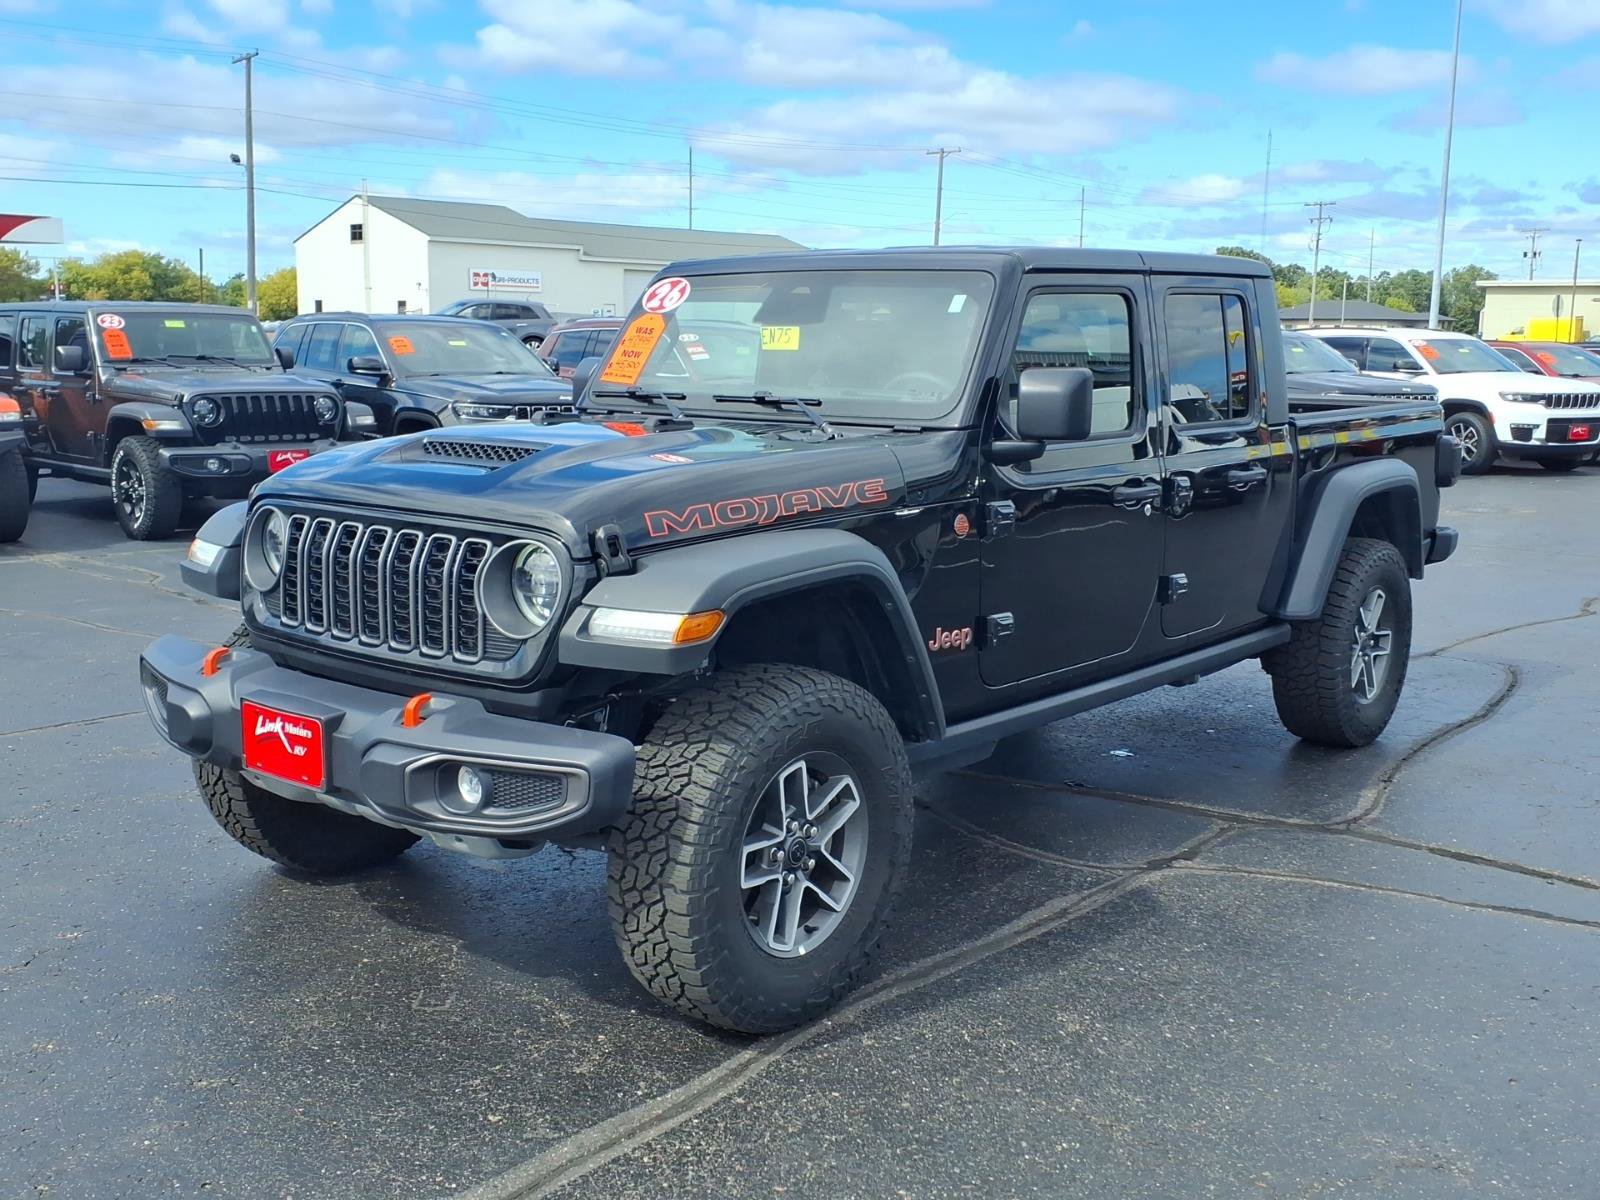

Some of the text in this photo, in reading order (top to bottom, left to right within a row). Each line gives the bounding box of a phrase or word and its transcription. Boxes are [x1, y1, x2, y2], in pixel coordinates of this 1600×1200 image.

[645, 280, 688, 309] 26
[635, 326, 655, 335] WAS
[622, 349, 643, 358] NOW
[644, 478, 888, 537] MOJAVE
[928, 626, 973, 651] Jeep
[284, 721, 312, 738] Motors
[293, 745, 308, 757] RV
